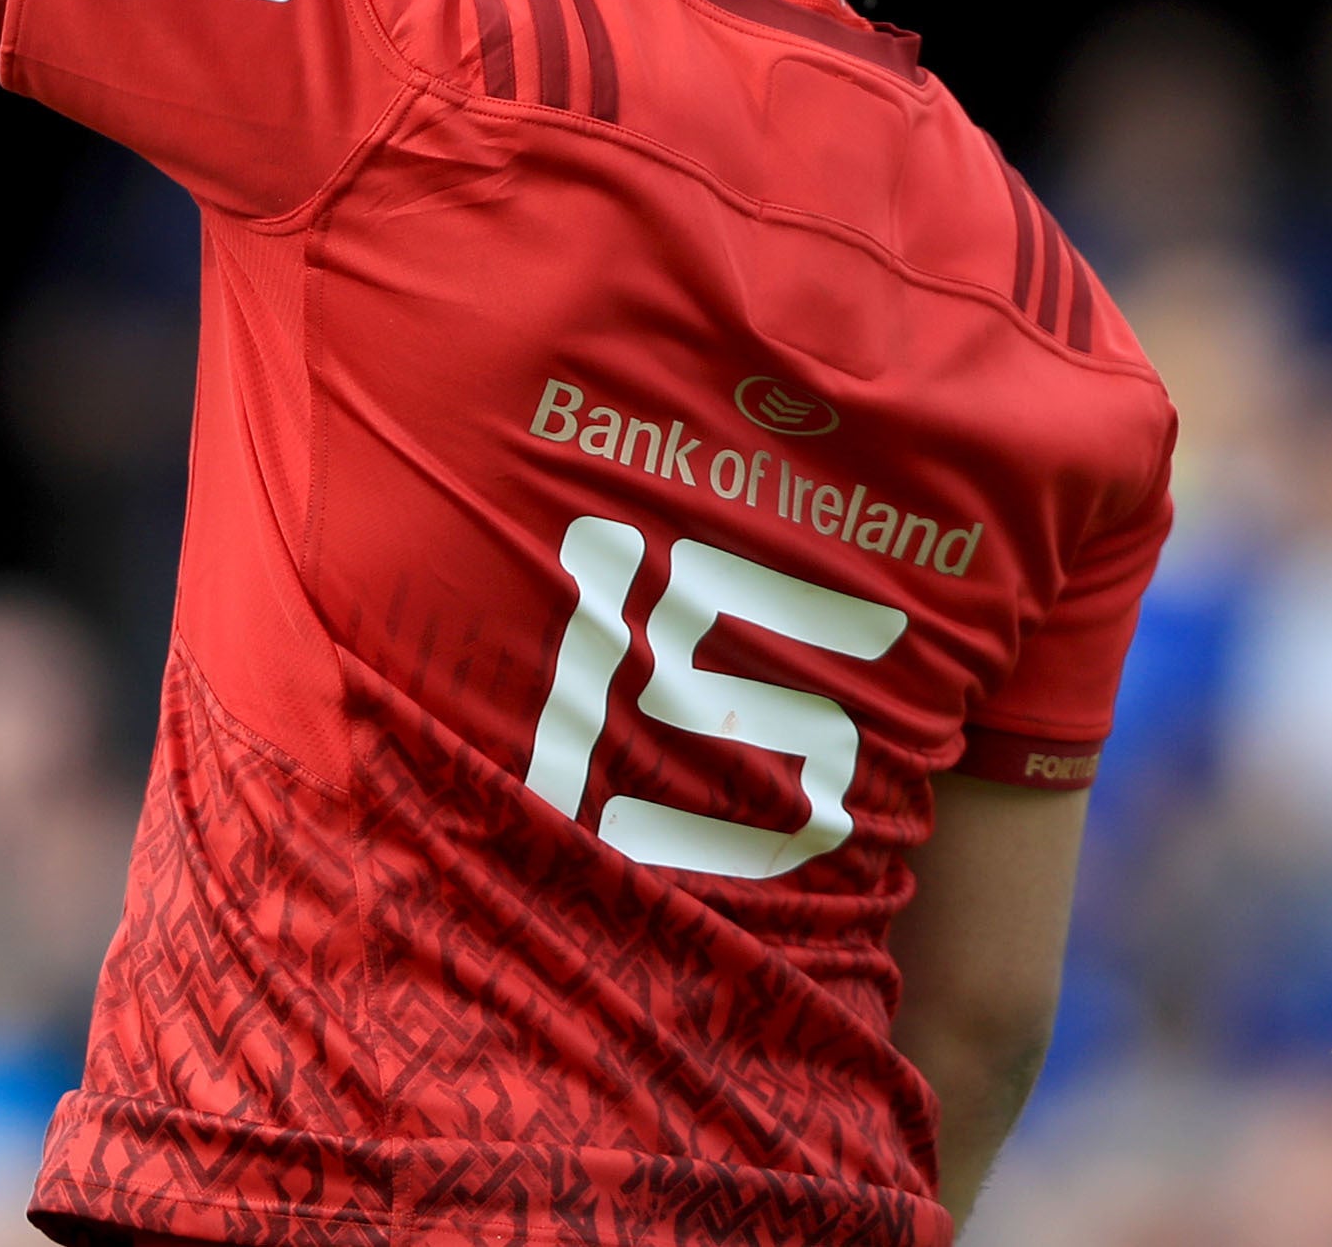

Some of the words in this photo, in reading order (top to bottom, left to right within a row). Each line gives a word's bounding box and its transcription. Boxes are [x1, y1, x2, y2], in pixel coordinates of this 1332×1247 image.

[528, 378, 700, 486] Bank
[709, 450, 772, 507] of
[778, 458, 984, 577] Ireland
[525, 515, 908, 879] 15
